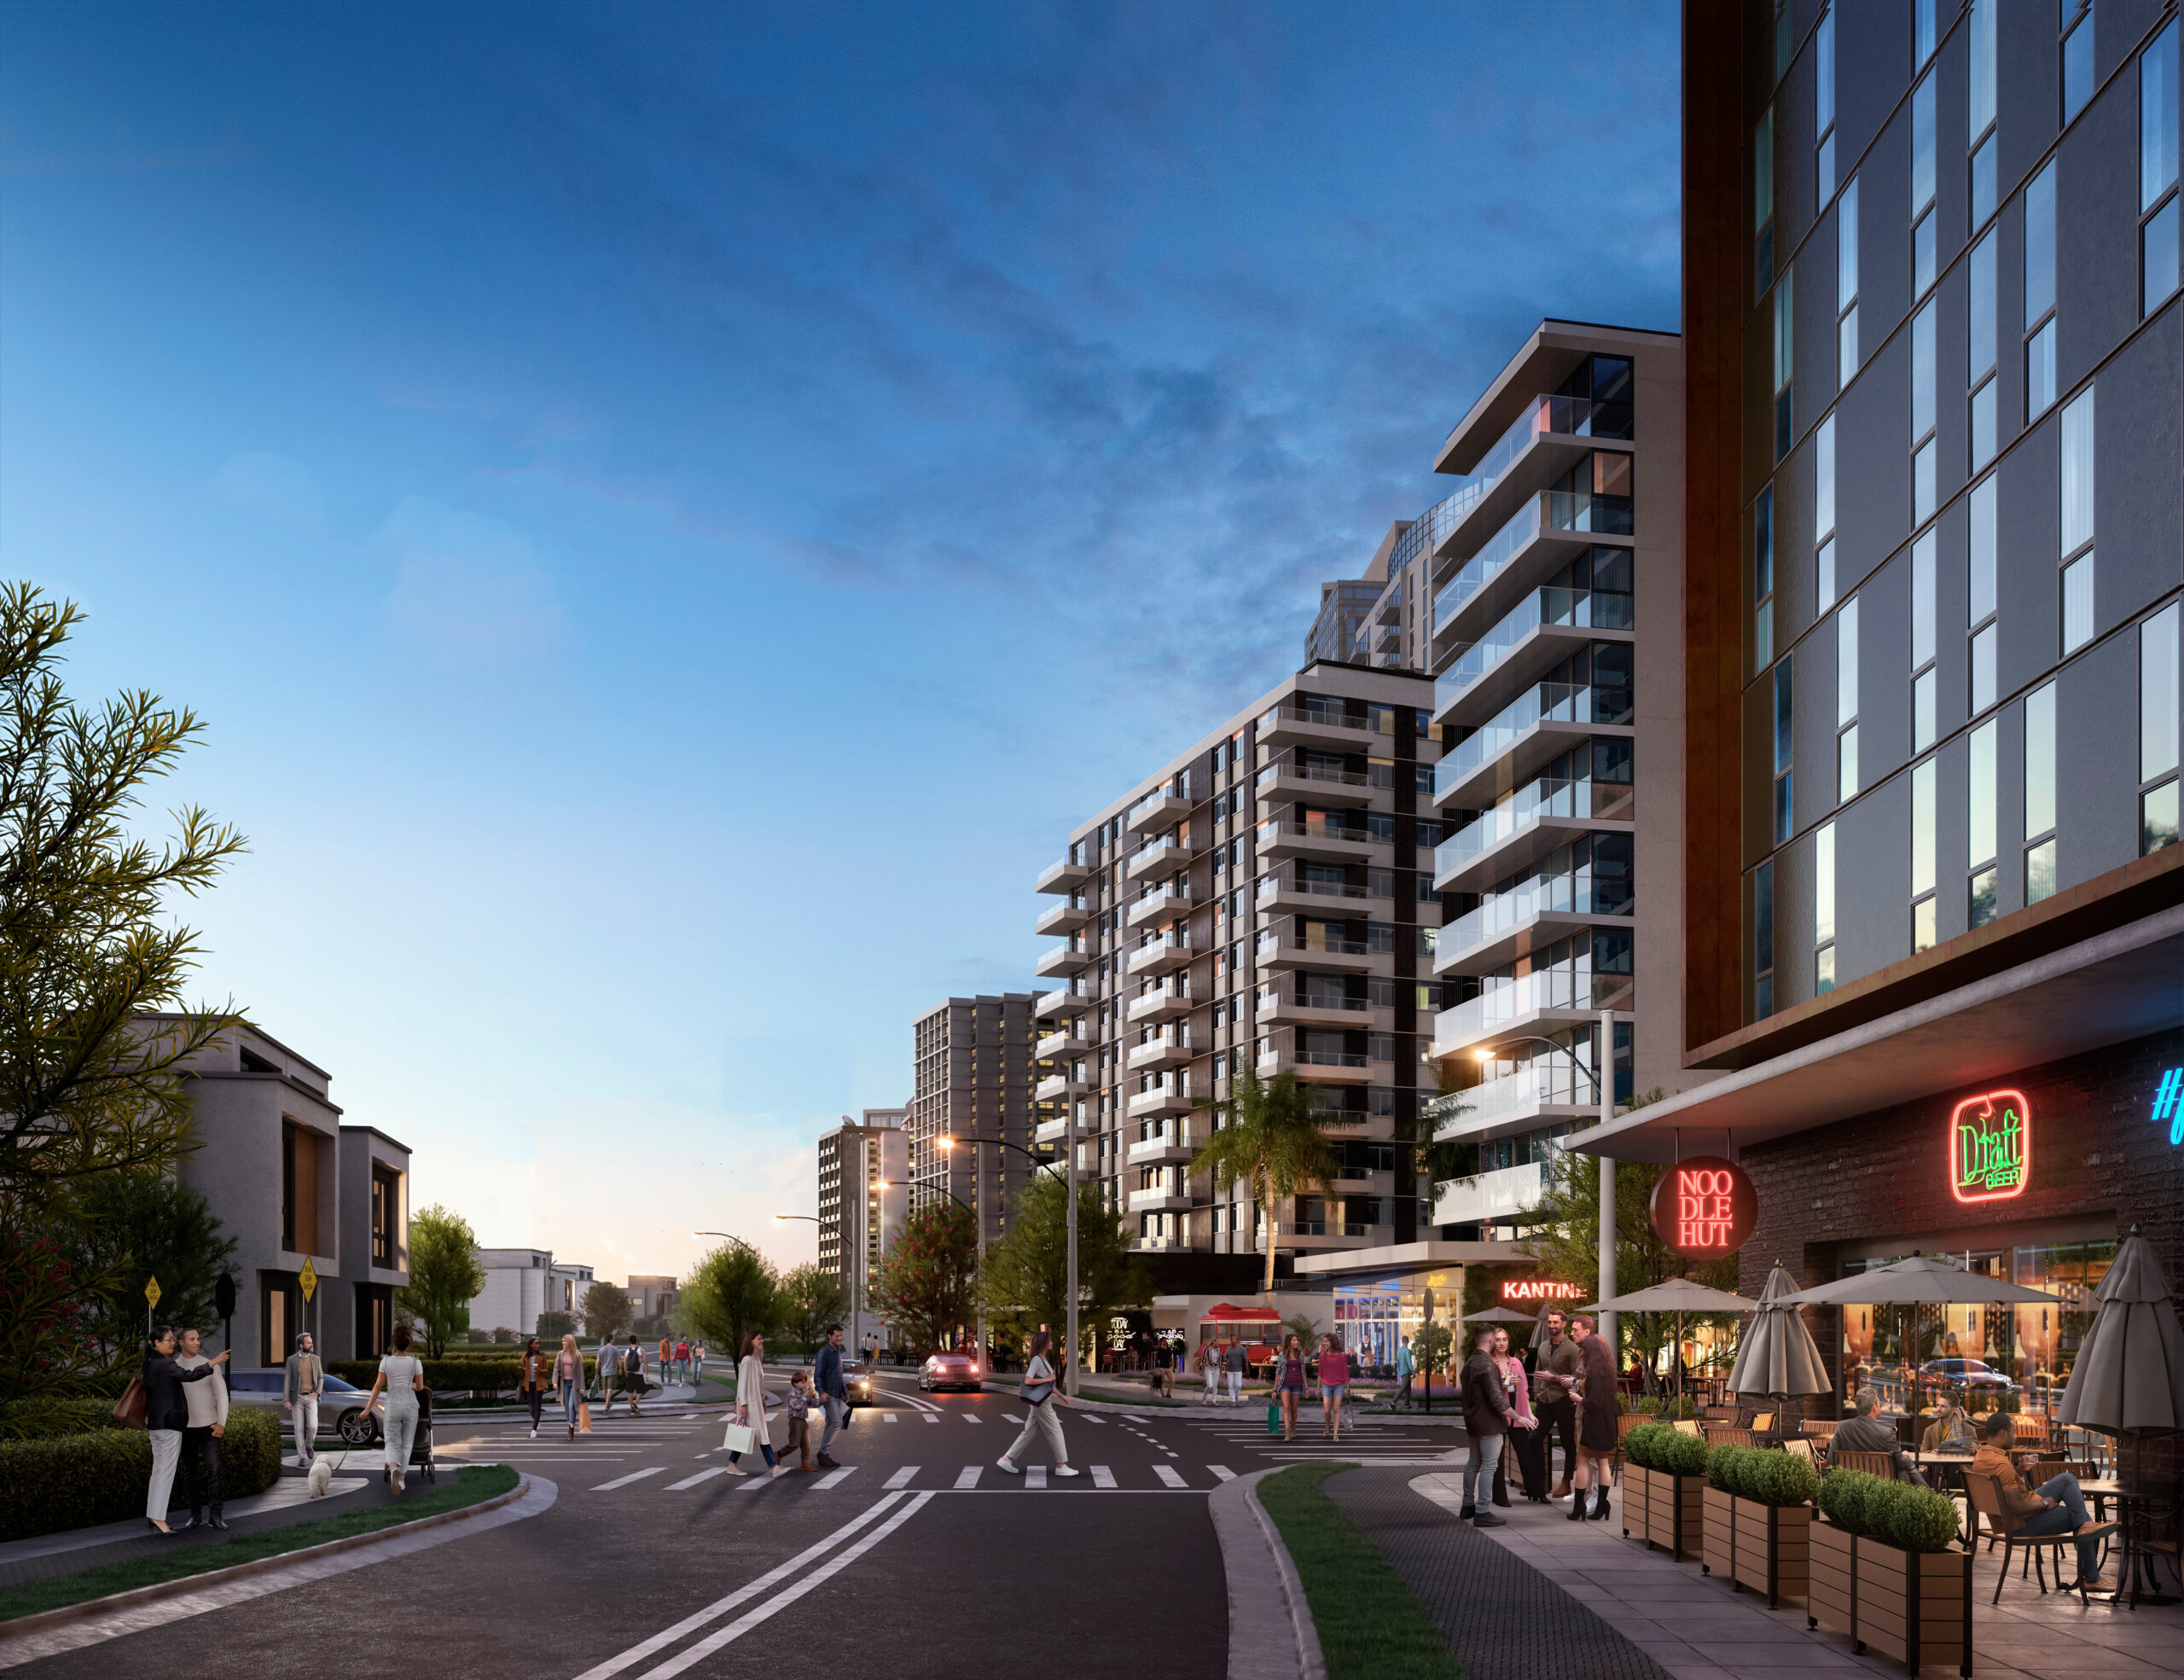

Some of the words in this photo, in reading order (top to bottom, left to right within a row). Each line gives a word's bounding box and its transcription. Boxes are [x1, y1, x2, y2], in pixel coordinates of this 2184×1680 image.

[1958, 1109, 2024, 1186] Draft
[1679, 1171, 1733, 1195] NOO
[1986, 1167, 2023, 1190] BEER
[1679, 1196, 1733, 1220] DLE
[1679, 1222, 1733, 1246] HUT
[1110, 1319, 1128, 1329] TODAY
[1107, 1331, 1136, 1342] good
[1113, 1339, 1125, 1348] DAY
